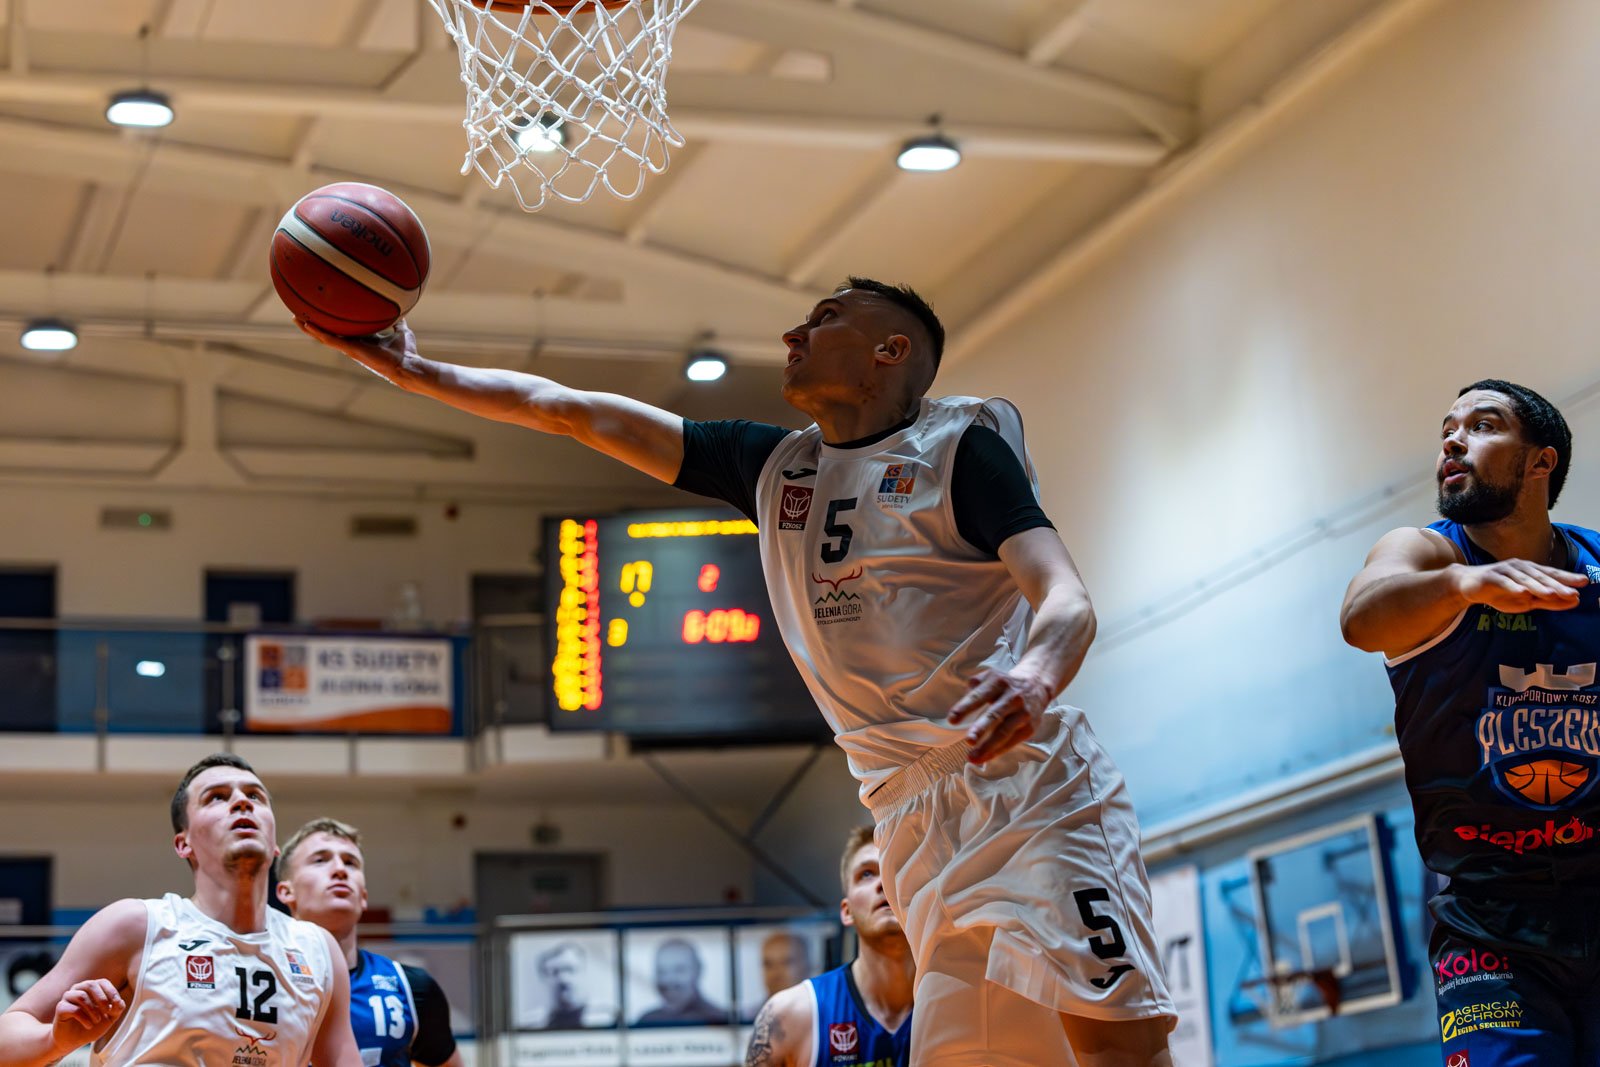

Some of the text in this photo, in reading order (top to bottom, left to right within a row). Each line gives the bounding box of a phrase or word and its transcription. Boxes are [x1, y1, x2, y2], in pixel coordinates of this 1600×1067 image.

[330, 209, 394, 257] molten
[876, 494, 911, 504] SUDETY
[821, 497, 858, 564] 5
[814, 606, 842, 619] JELENIA
[1573, 694, 1598, 704] KOSZ
[1073, 888, 1126, 960] 5
[1456, 974, 1482, 986] kolorowa
[235, 966, 278, 1024] 12
[368, 995, 406, 1039] 13
[1455, 1001, 1519, 1018] AGENCJA
[1456, 1010, 1524, 1026] OCHRONY
[1457, 1020, 1521, 1036] EGIDA SECURITY
